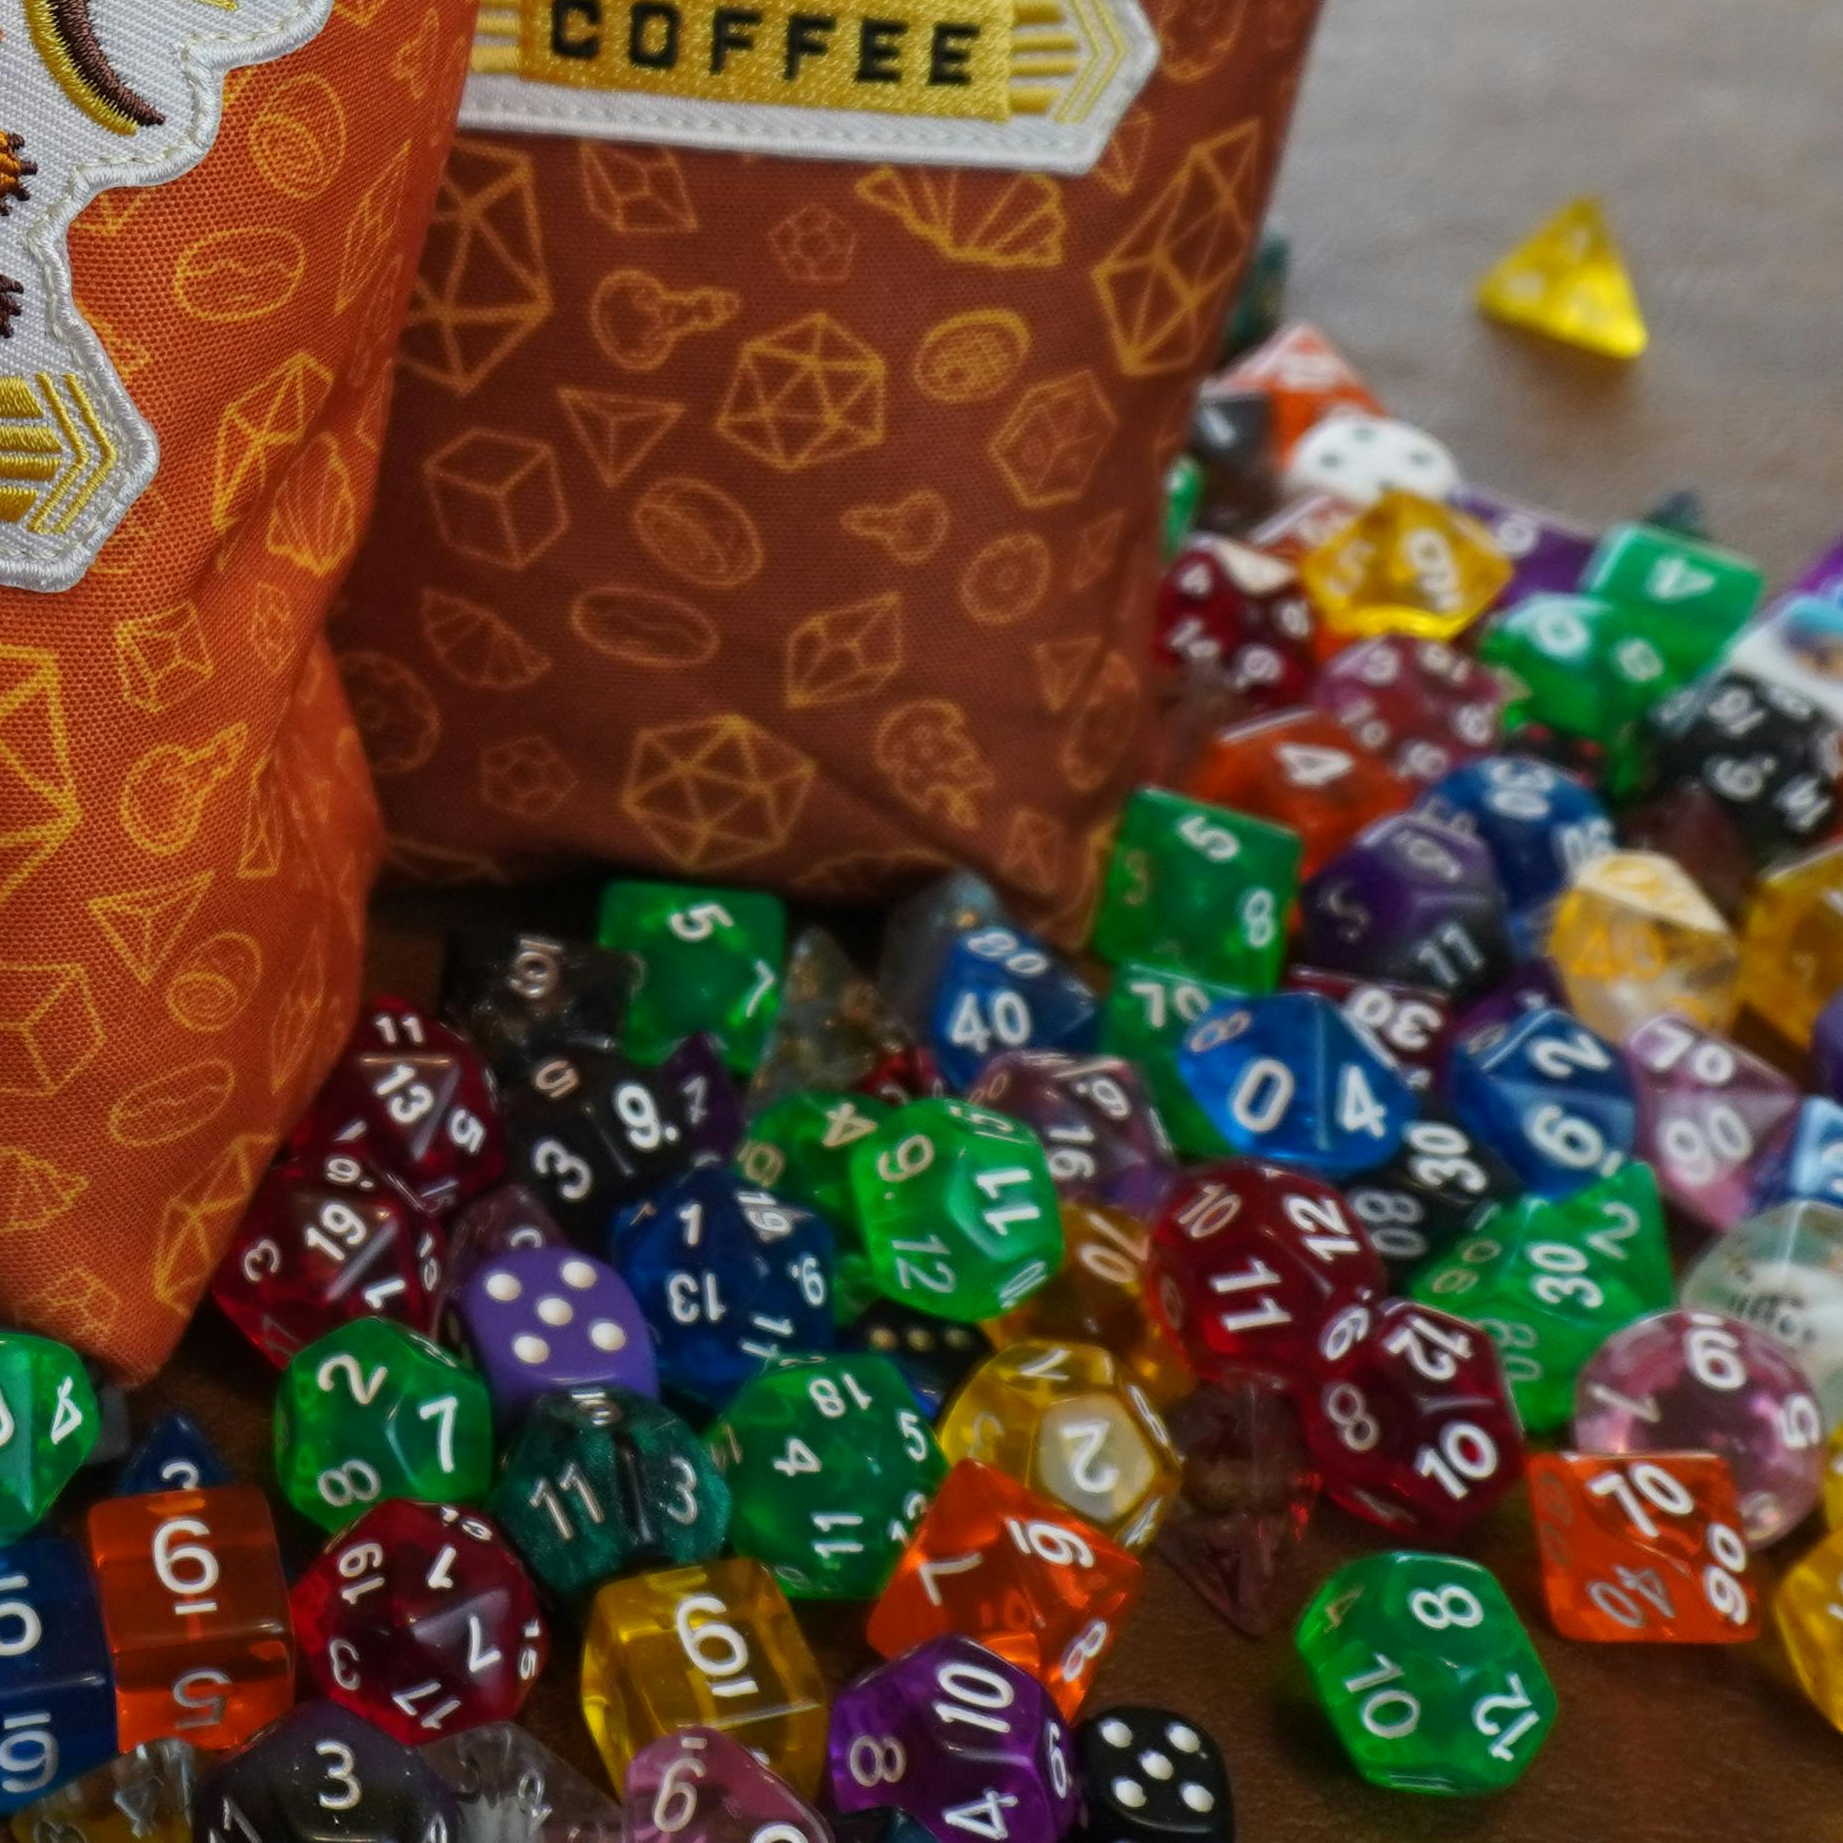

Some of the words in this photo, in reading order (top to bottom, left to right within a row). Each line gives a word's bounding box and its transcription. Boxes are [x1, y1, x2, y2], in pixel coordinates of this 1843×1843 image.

[1176, 815, 1241, 864] 5
[669, 903, 734, 941] 5
[1241, 889, 1276, 948] 8
[967, 931, 1049, 976] 80
[375, 1015, 424, 1043] 11
[949, 991, 1031, 1052] 40
[1352, 988, 1443, 1049] 30
[1530, 1035, 1610, 1079] 2
[374, 1064, 434, 1124] 13
[1232, 1059, 1294, 1133] 0
[1337, 1065, 1387, 1138] 4
[449, 1110, 487, 1154] 5
[1403, 1121, 1488, 1192] 30
[533, 1139, 592, 1200] 3
[305, 1204, 367, 1260] 19
[680, 1204, 702, 1245] 1
[975, 1168, 1040, 1236] 11
[1177, 1182, 1243, 1239] 10
[1283, 1194, 1360, 1262] 12
[1352, 1188, 1427, 1257] 80
[1587, 1201, 1640, 1260] 2
[892, 1235, 956, 1294] 12
[1210, 1258, 1292, 1332] 11
[1526, 1243, 1603, 1308] 30
[666, 1274, 725, 1324] 13
[1385, 1314, 1472, 1380] 12
[318, 1354, 388, 1405] 2
[808, 1373, 872, 1419] 18
[52, 1377, 83, 1444] 4
[420, 1396, 458, 1474] 7
[896, 1411, 926, 1461] 5
[1326, 1384, 1379, 1451] 8
[1779, 1394, 1820, 1450] 5
[318, 1460, 381, 1506] 8
[774, 1438, 821, 1477] 4
[1061, 1420, 1120, 1494] 2
[1415, 1421, 1498, 1500] 10
[530, 1462, 605, 1541] 11
[665, 1457, 697, 1525] 3
[1588, 1462, 1693, 1538] 70
[810, 1512, 863, 1558] 11
[152, 1517, 220, 1615] 6
[1409, 1585, 1485, 1630] 8
[675, 1593, 758, 1698] 6
[1061, 1619, 1108, 1684] 8
[934, 1662, 1014, 1734] 10
[1345, 1653, 1420, 1739] 10
[1473, 1672, 1540, 1762] 12
[315, 1741, 361, 1810] 3
[848, 1734, 906, 1787] 8
[941, 1790, 1017, 1841] 4
